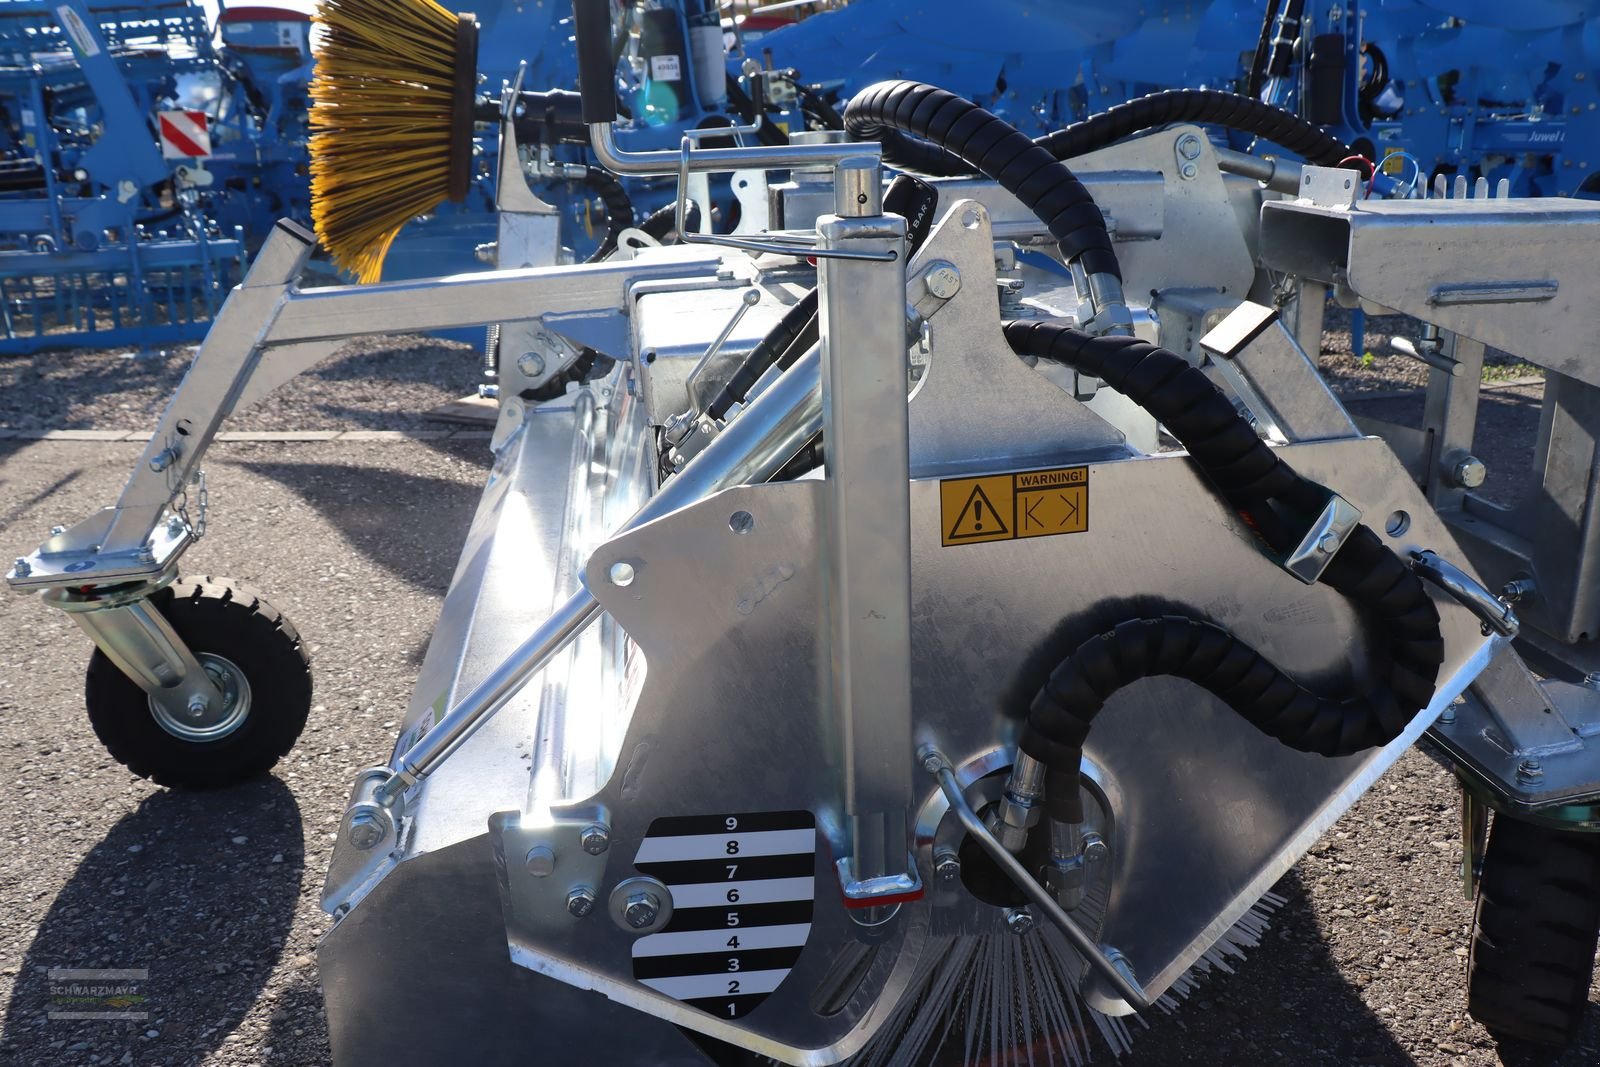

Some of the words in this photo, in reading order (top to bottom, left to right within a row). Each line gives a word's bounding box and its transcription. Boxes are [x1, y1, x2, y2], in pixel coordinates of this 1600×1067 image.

[1528, 130, 1560, 142] Juwel
[912, 203, 928, 229] BAR
[939, 269, 959, 285] FAST
[1020, 470, 1083, 486] WARNING!
[725, 816, 738, 831] 9
[726, 840, 739, 855] 8
[725, 864, 738, 879] 7
[726, 888, 740, 903] 6
[727, 912, 740, 926] 5
[726, 935, 740, 949] 4
[727, 958, 740, 972] 3
[727, 980, 740, 994] 2
[727, 1002, 736, 1016] 1
